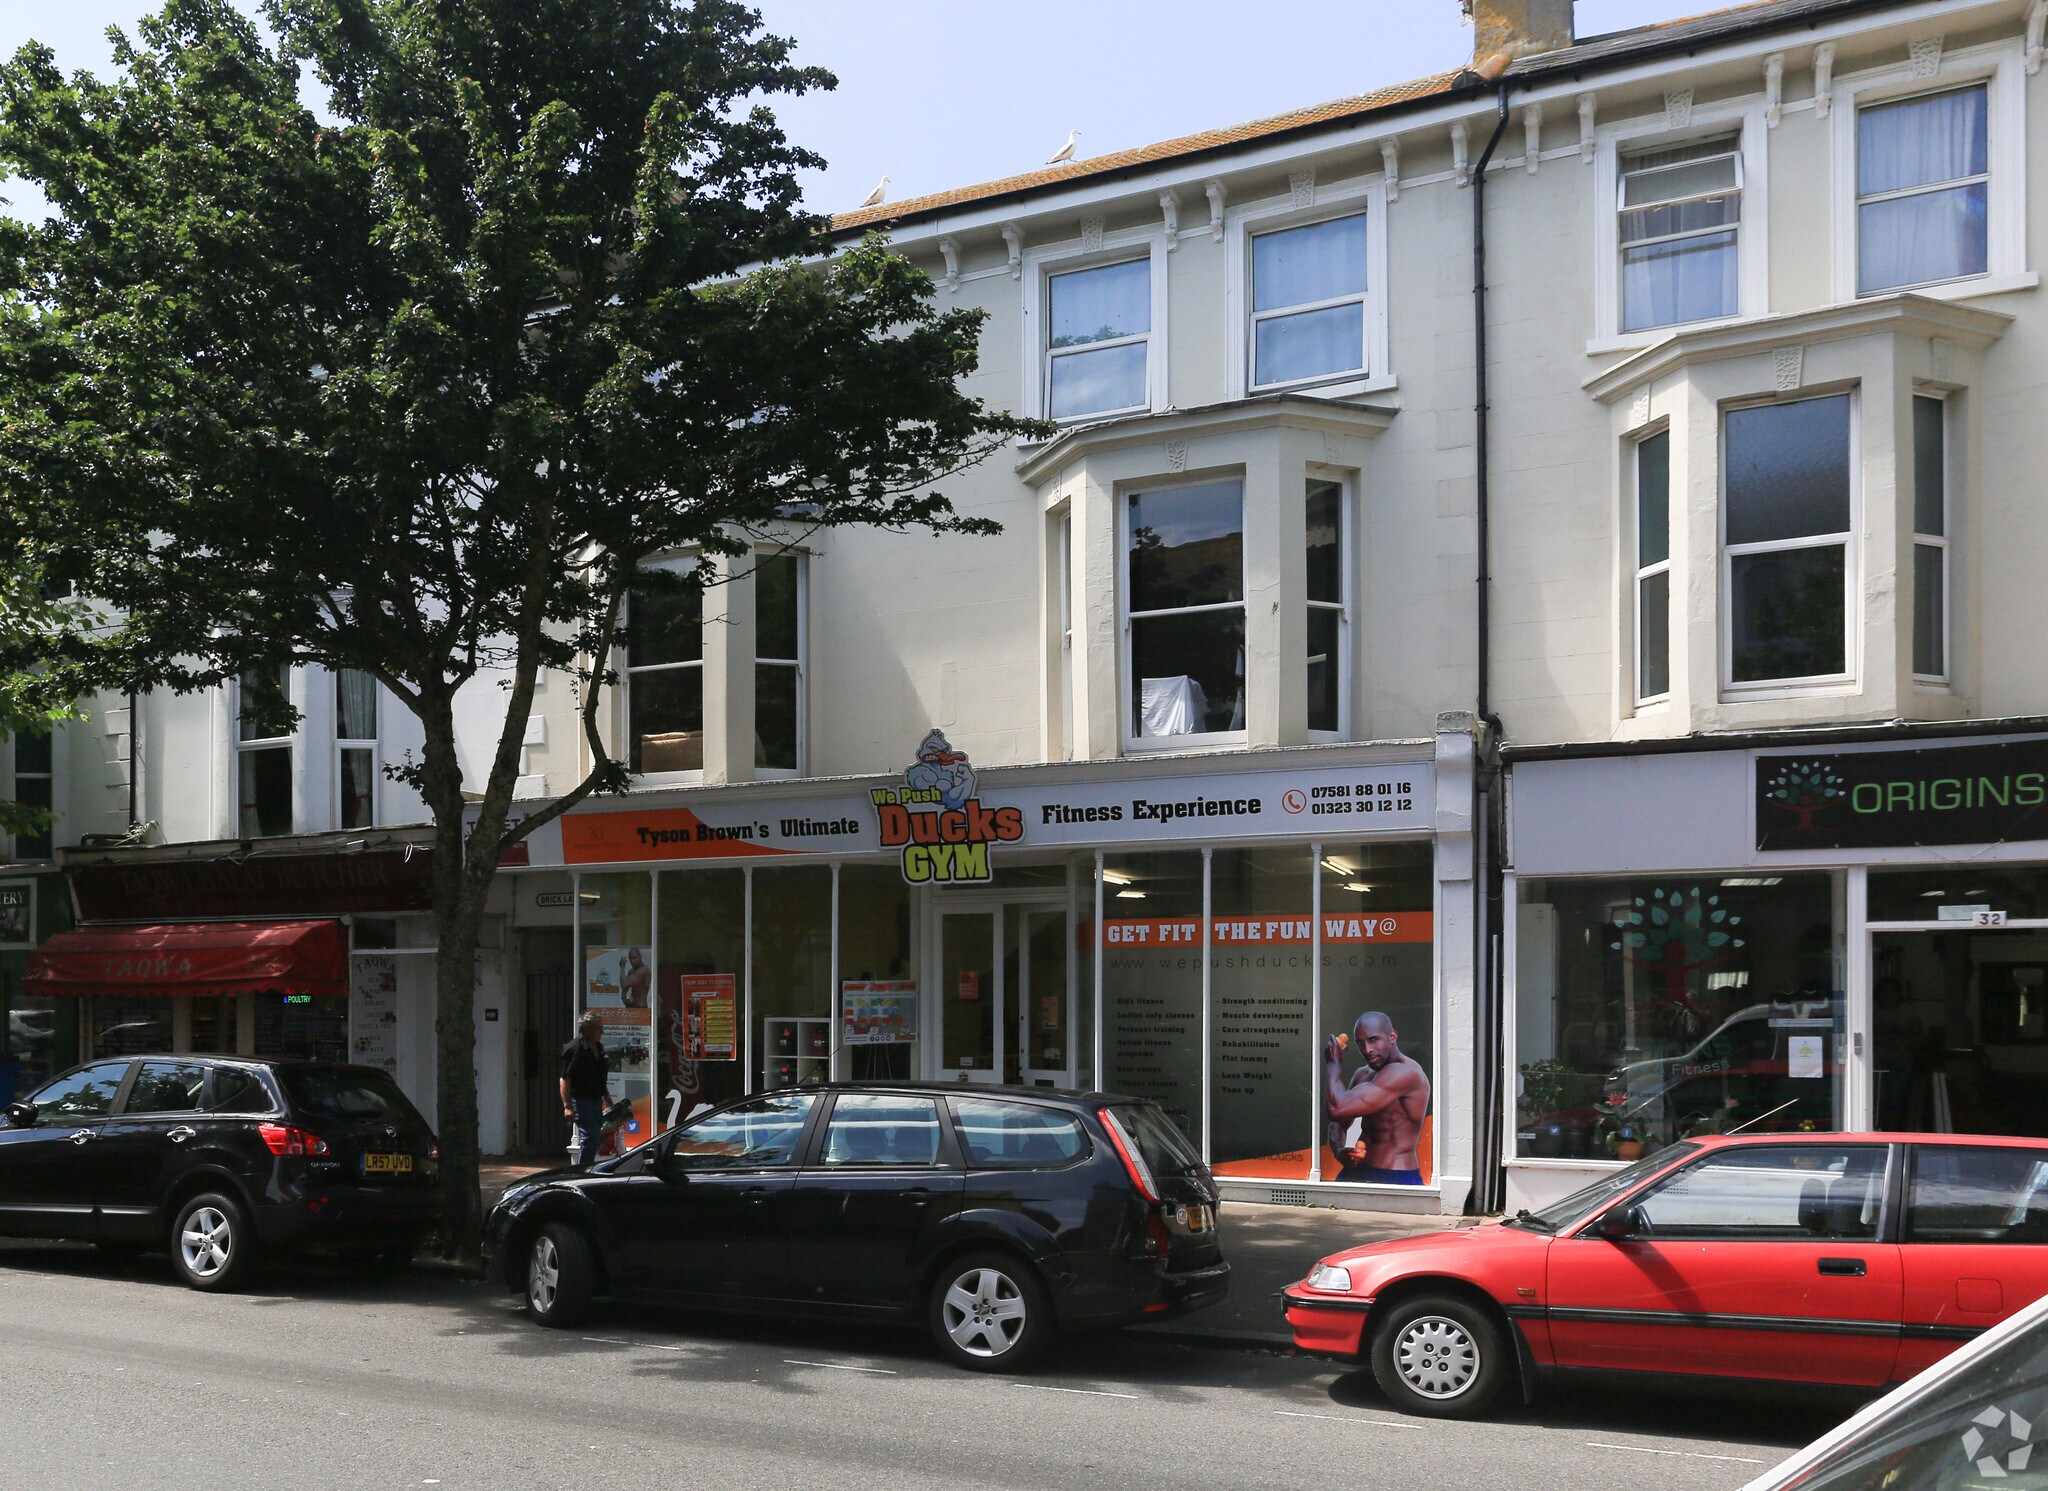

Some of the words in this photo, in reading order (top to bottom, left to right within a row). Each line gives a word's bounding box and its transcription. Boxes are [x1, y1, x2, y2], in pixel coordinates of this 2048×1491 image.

[871, 788, 897, 805] We
[899, 785, 942, 804] Push
[1311, 785, 1351, 799] 07581
[1355, 784, 1373, 797] 88
[1377, 783, 1392, 795] 01
[1397, 782, 1412, 794] 16
[1852, 773, 2045, 814] ORIGINS
[1042, 804, 1123, 824] Fitness
[1132, 796, 1261, 823] Experience
[1311, 801, 1352, 815] 01323
[1356, 800, 1374, 813] 30
[1378, 800, 1392, 812] 12
[1397, 798, 1412, 811] 12
[877, 798, 1023, 847] Ducks
[637, 826, 691, 848] Tyson
[696, 820, 770, 843] Brown's
[780, 817, 860, 838] Ultimate
[903, 841, 990, 881] GYM
[0, 890, 24, 905] ERY
[541, 895, 562, 904] BRICK
[1979, 913, 2001, 925] 32
[1107, 925, 1150, 943] GET
[1159, 924, 1196, 942] FIT
[1214, 922, 1261, 940] THE
[1265, 921, 1311, 939] FUN
[104, 954, 192, 978] TAQWA
[355, 956, 395, 974] TAQWA
[288, 995, 311, 1004] POULTRY
[1222, 997, 1256, 1006] Strength
[1258, 997, 1308, 1006] conditioning
[601, 1008, 615, 1018] Epic
[617, 1008, 640, 1018] Fitness
[1145, 1012, 1162, 1020] only
[1252, 1012, 1303, 1020] development
[1153, 1026, 1185, 1034] training
[1222, 1026, 1240, 1034] Core
[1243, 1026, 1300, 1035] strengthening
[1222, 1040, 1280, 1048] Rehabilitation
[1240, 1055, 1268, 1064] tummy
[1671, 1060, 1731, 1076] Fitness
[1243, 1072, 1272, 1080] Weight
[1245, 1087, 1255, 1095] up
[365, 1154, 390, 1169] LR57
[392, 1154, 410, 1169] UVD
